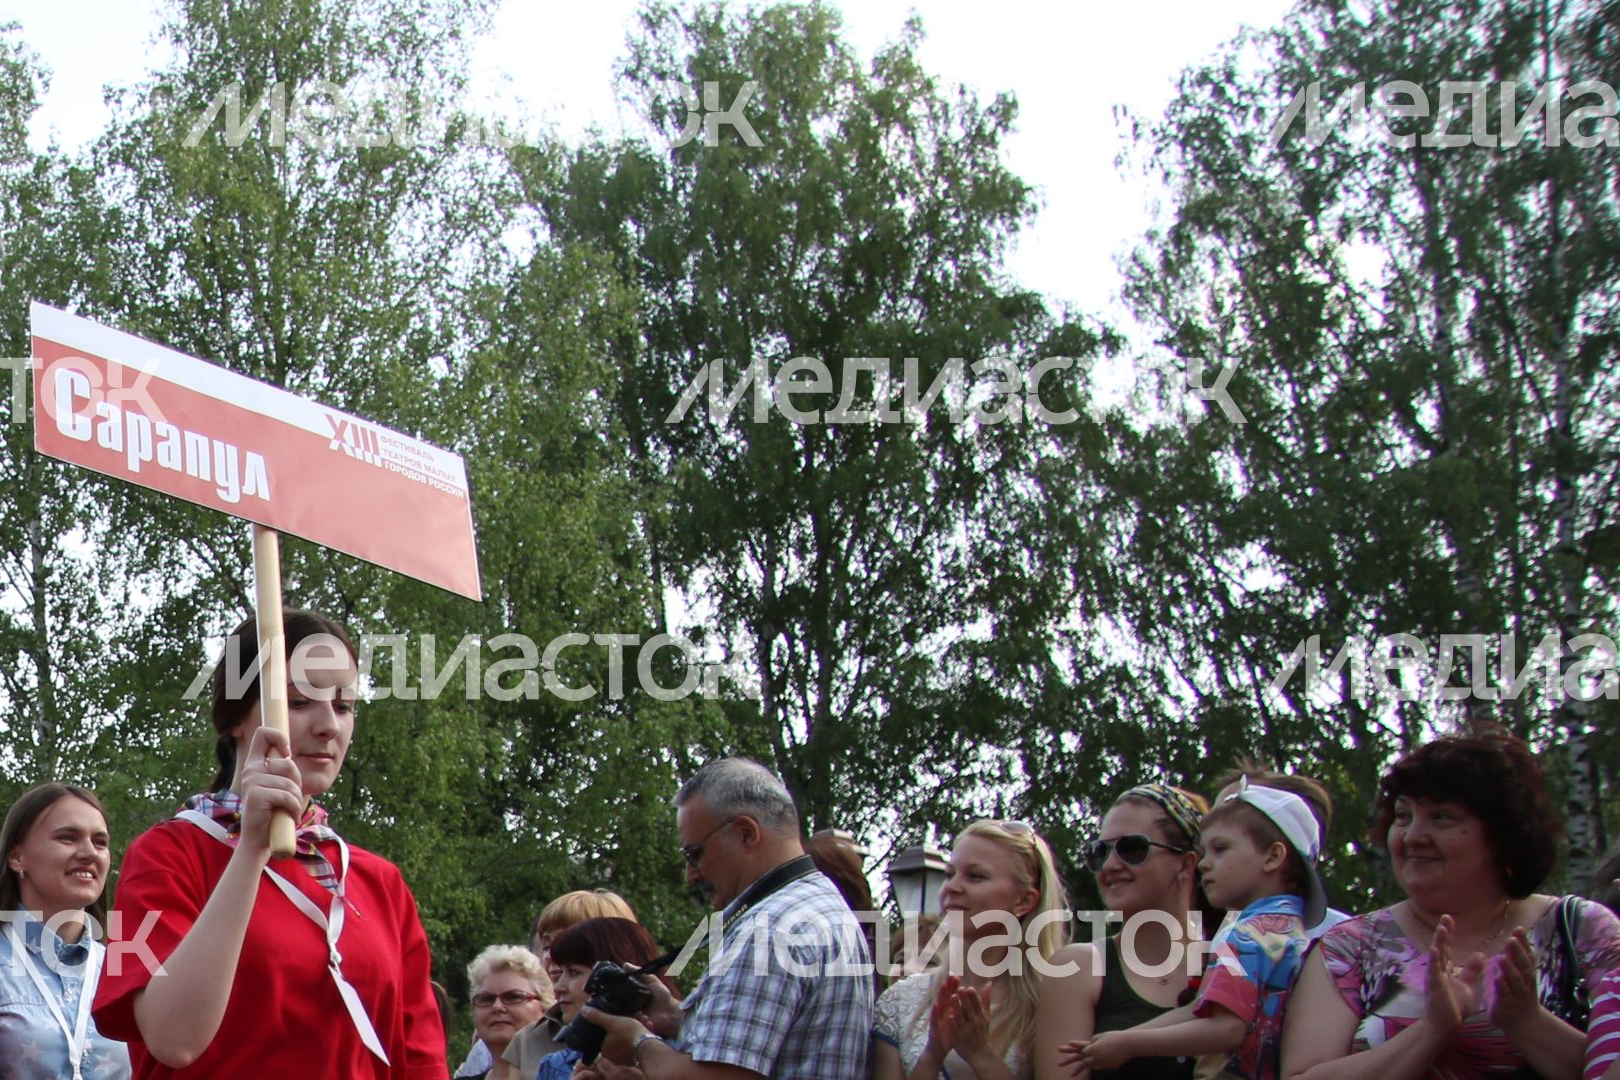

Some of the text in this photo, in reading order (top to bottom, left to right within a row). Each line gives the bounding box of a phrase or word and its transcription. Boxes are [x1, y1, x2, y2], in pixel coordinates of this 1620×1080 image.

[54, 367, 271, 503] Сарапул
[324, 412, 383, 468] XIII
[380, 435, 435, 462] ФЕСТИВАЛЬ
[383, 448, 459, 483] ТЕАТРОВ МАЛЫХ
[384, 461, 465, 499] ГОРОДОВ РОССИИ
